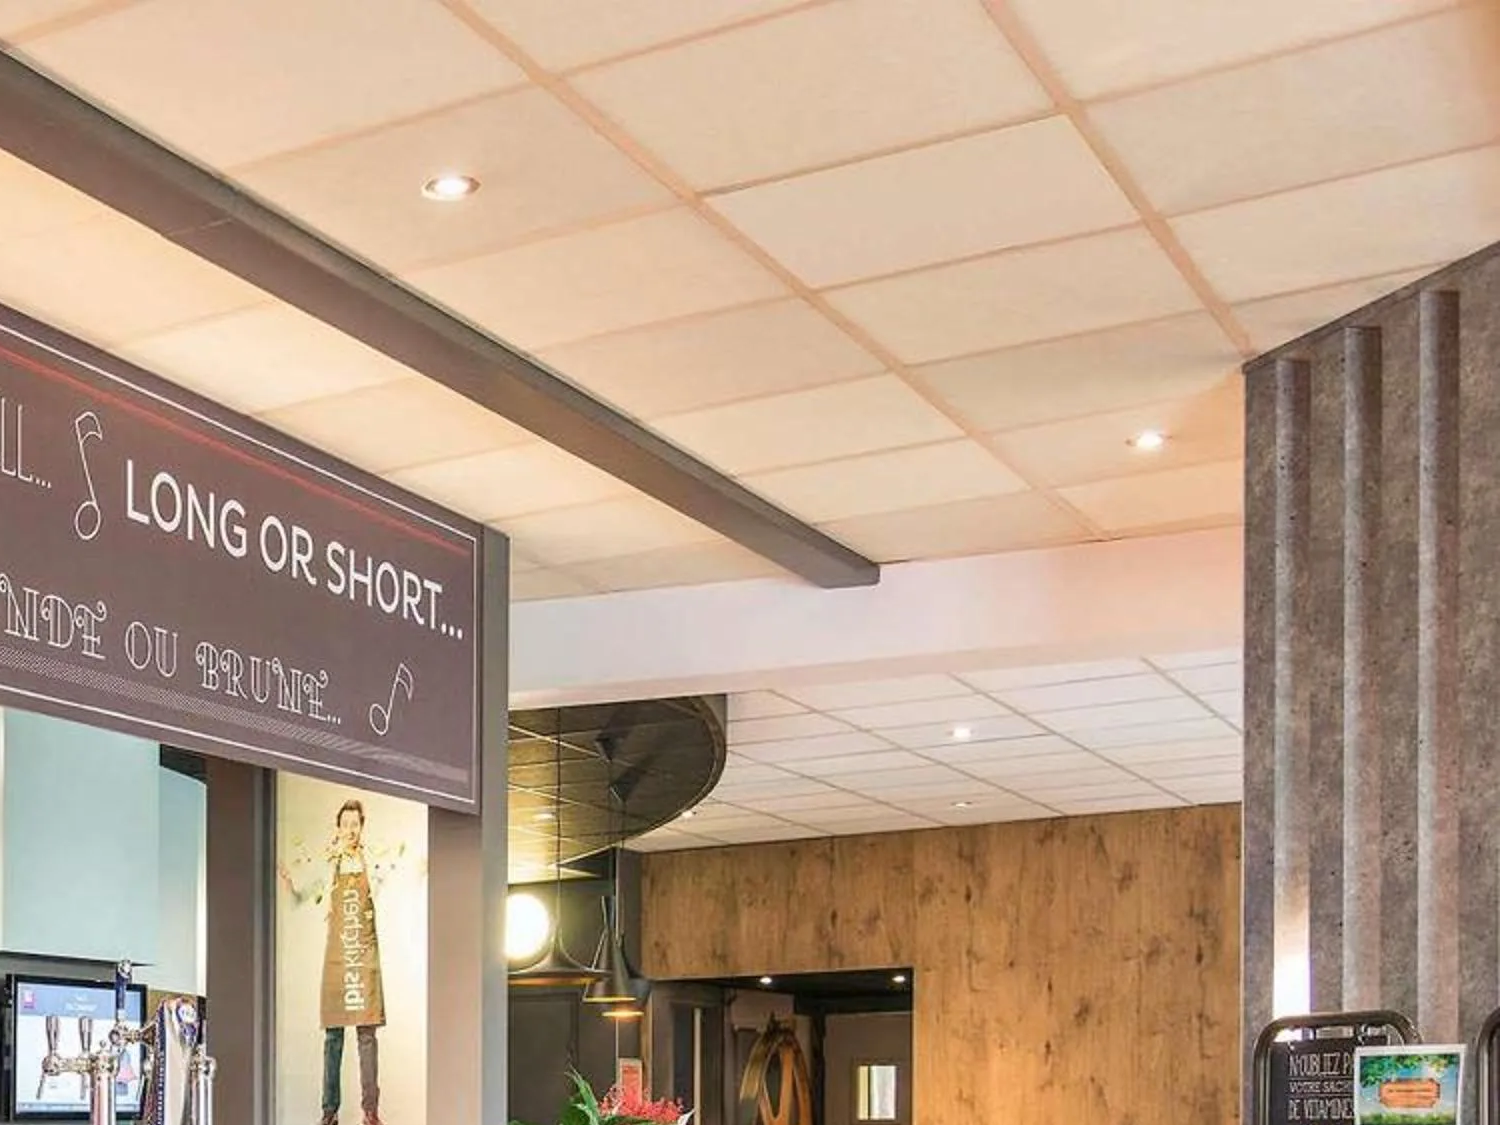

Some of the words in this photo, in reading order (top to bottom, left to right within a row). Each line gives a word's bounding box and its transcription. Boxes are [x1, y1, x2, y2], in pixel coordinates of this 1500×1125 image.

[126, 459, 248, 558] LONG
[260, 515, 317, 587] OR
[125, 620, 179, 678] OU
